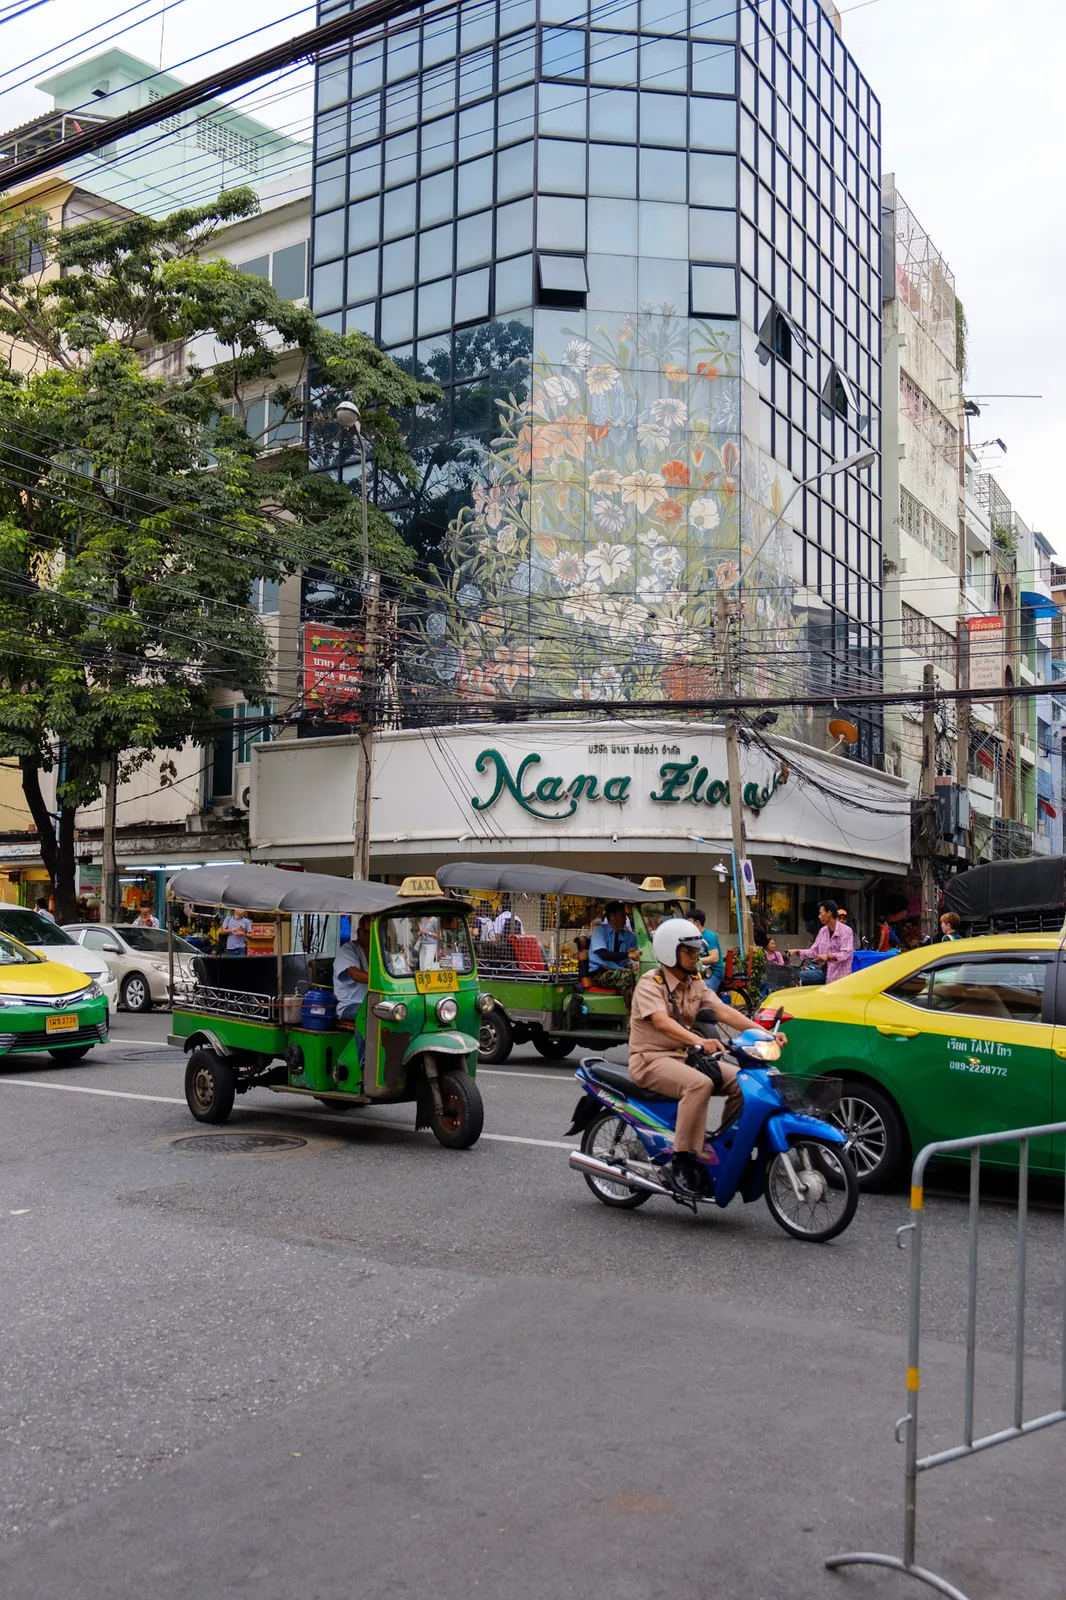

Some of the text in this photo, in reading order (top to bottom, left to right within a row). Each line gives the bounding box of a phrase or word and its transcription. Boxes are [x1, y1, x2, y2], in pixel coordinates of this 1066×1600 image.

[471, 748, 632, 820] Nana
[411, 880, 435, 891] TAXI
[437, 972, 454, 984] 439
[971, 1039, 994, 1054] TAXI
[996, 1043, 1012, 1057] โทร
[949, 1061, 1007, 1076] 089-2228772
